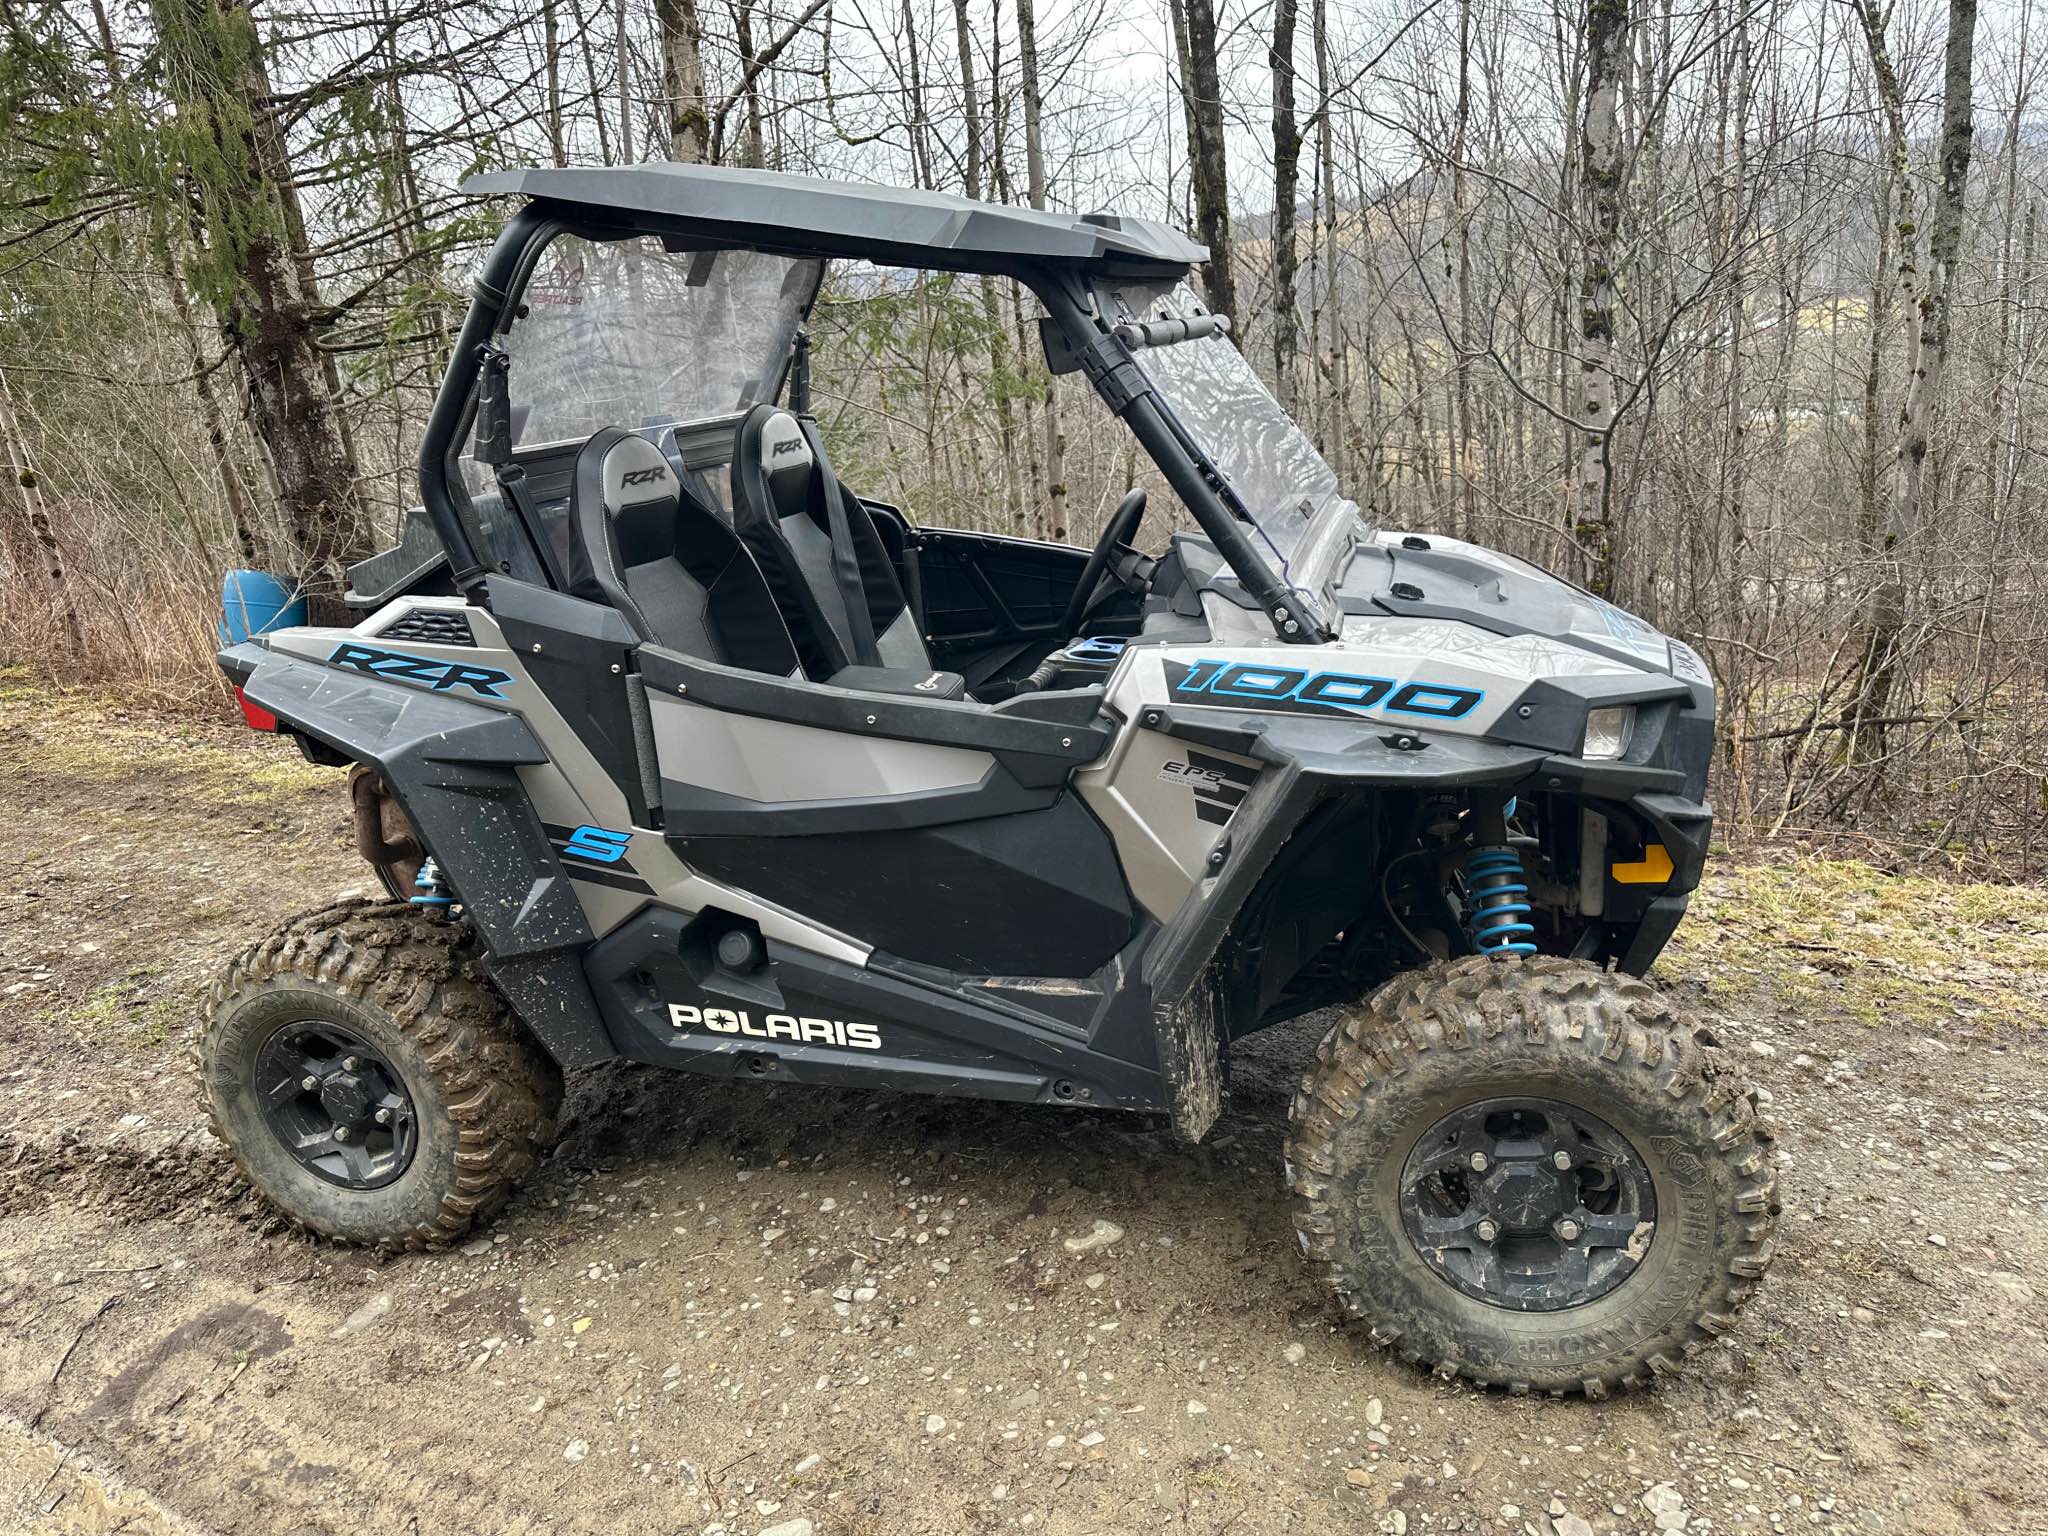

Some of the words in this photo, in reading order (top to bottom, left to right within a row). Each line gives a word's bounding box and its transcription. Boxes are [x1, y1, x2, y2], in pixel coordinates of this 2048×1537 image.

[772, 438, 803, 458] RZR
[620, 466, 666, 490] RZR
[328, 642, 514, 699] RZR
[1177, 658, 1486, 720] 1000
[1162, 761, 1225, 783] EPS
[562, 824, 634, 863] S
[667, 1003, 882, 1050] POLARIS
